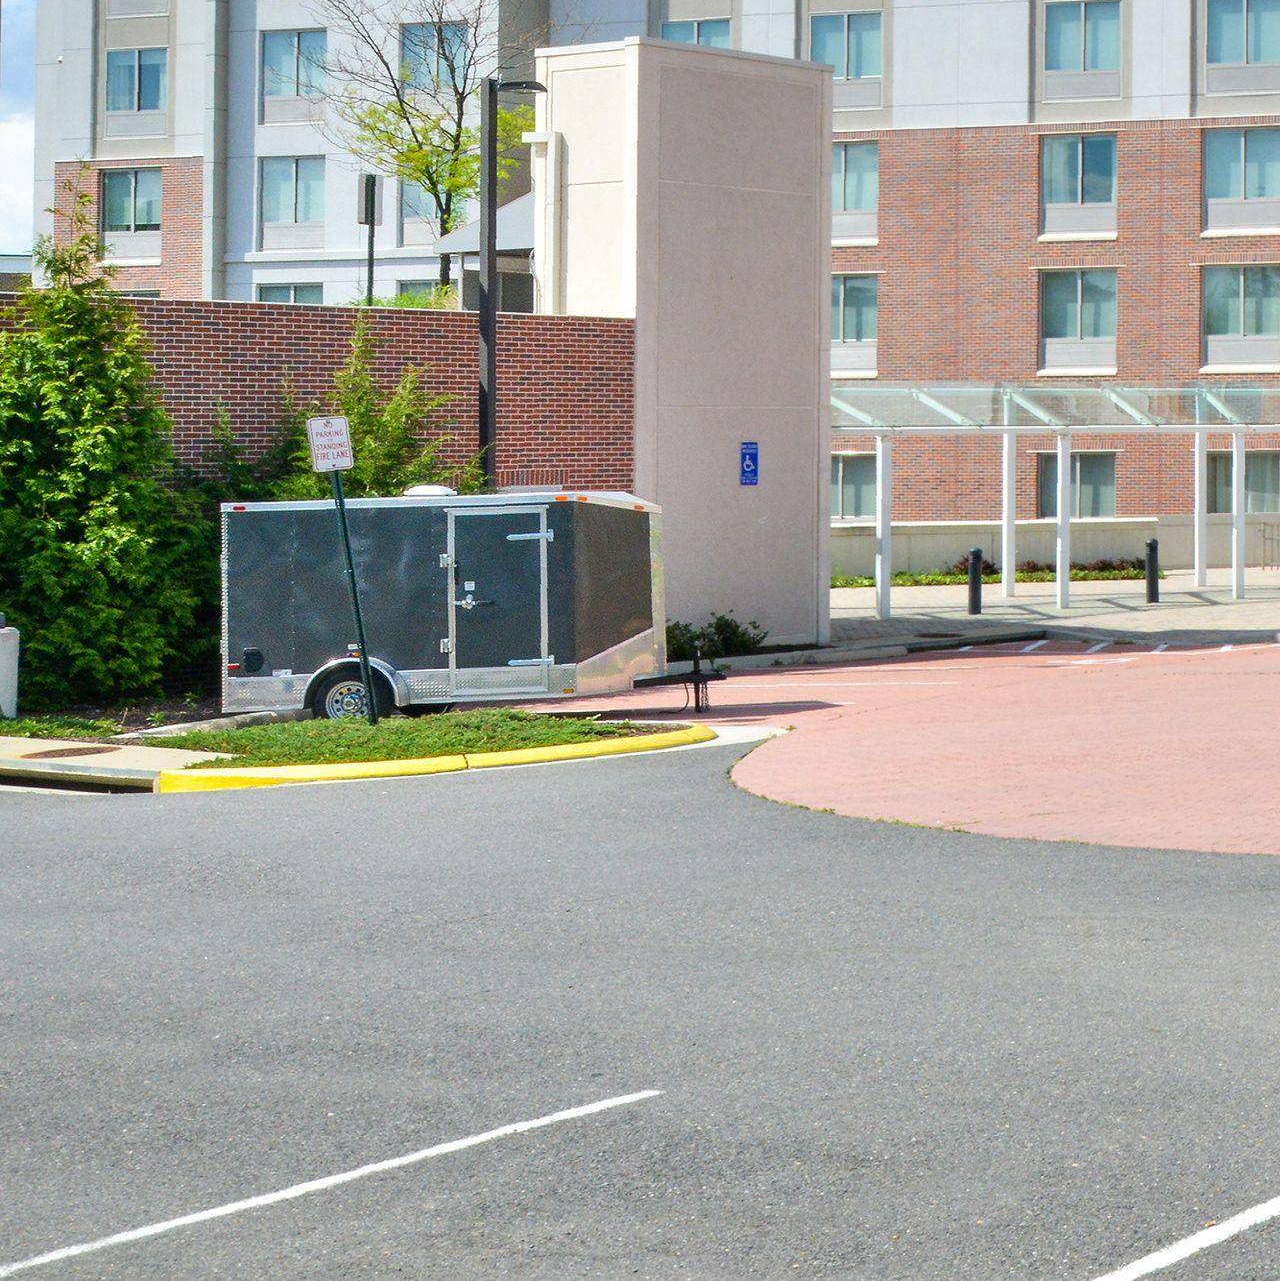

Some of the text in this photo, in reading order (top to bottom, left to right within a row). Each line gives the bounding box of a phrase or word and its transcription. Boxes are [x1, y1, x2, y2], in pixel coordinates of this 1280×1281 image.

[315, 429, 344, 438] PARKING
[315, 441, 347, 451] STANDING
[316, 449, 350, 461] FIRE LANE
